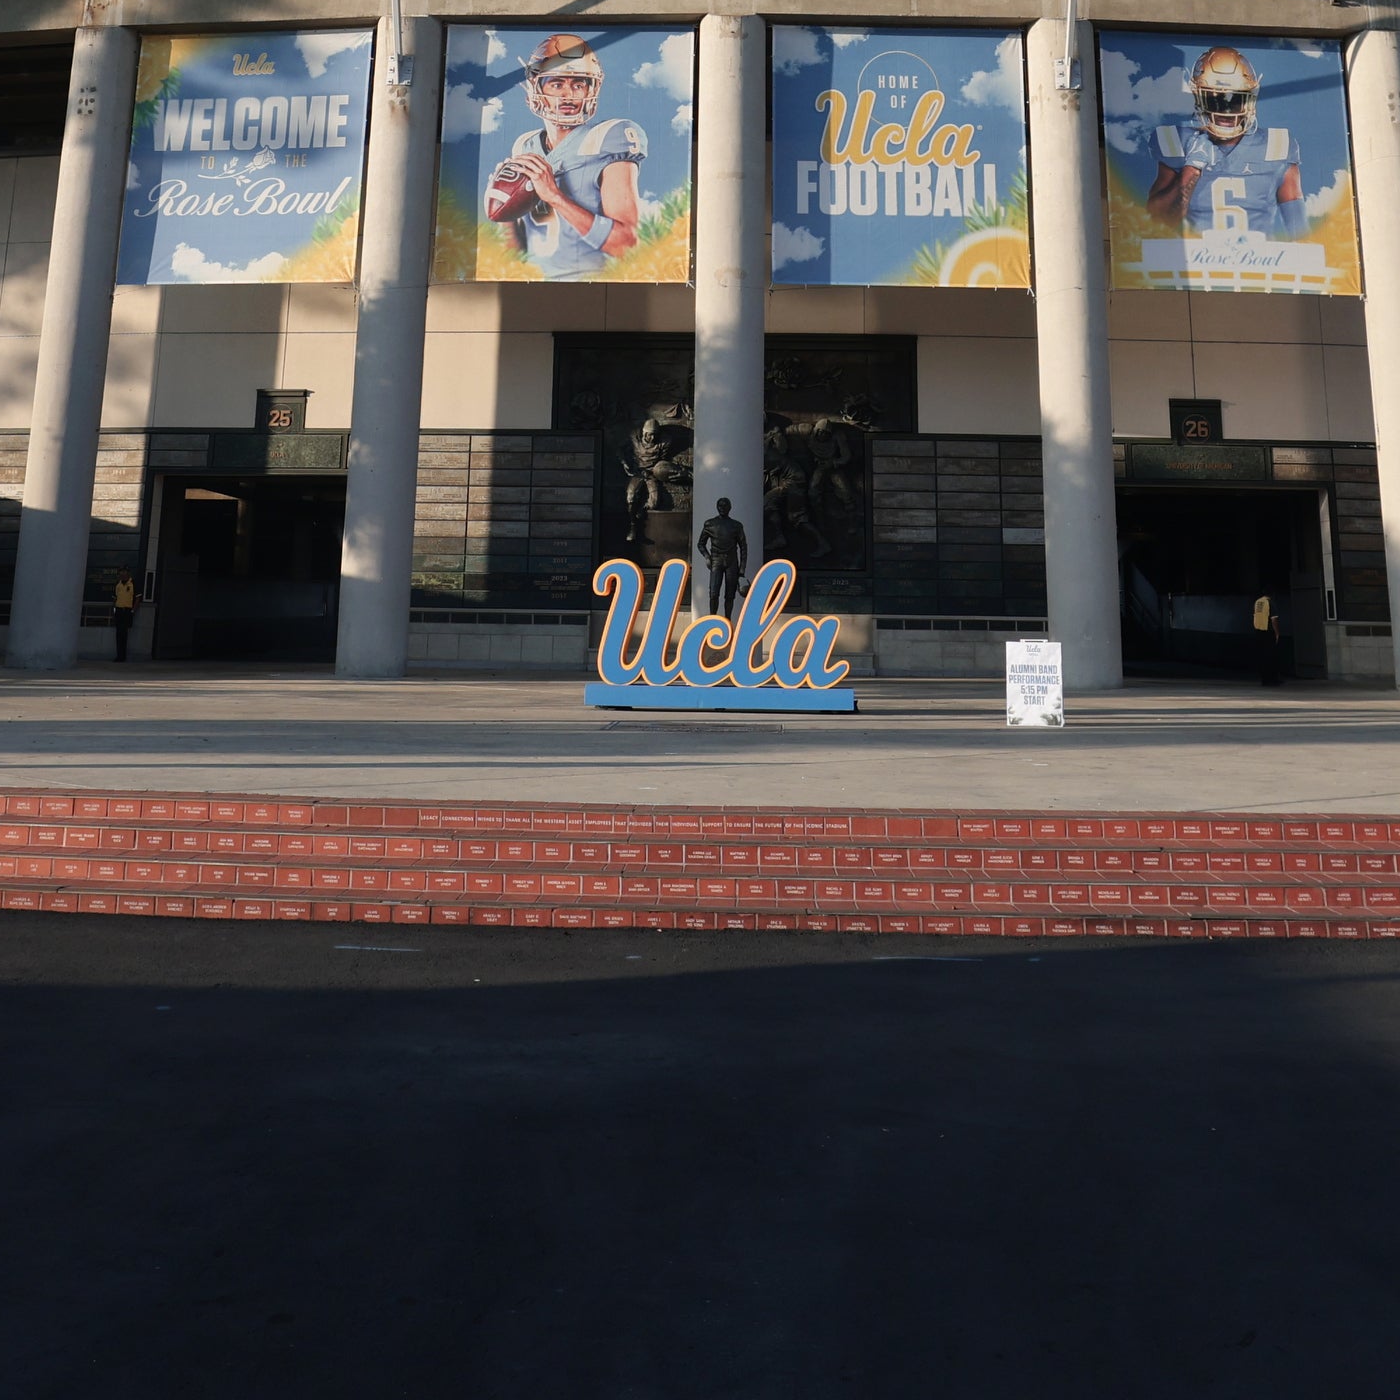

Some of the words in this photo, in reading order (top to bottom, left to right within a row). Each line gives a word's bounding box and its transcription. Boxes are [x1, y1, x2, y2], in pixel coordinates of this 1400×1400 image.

[232, 53, 275, 76] Ucla
[877, 75, 919, 90] HOME
[890, 94, 907, 110] OF
[153, 94, 350, 152] WELCOME
[815, 89, 981, 168] Ucla
[201, 155, 215, 170] TO
[285, 154, 308, 168] THE
[134, 179, 235, 218] Rose
[234, 176, 353, 217] Bowl
[797, 160, 1004, 218] FOOTBALL
[1189, 247, 1232, 268] Rose
[1230, 246, 1285, 268] Bowl
[268, 409, 292, 427] 25
[1184, 420, 1209, 438] 26
[592, 559, 851, 689] Ucla
[1010, 664, 1037, 674] ALUMNI
[1038, 665, 1058, 674] BAND
[1008, 675, 1060, 684] PERFORMANCE
[1020, 685, 1035, 694] 5:15
[1036, 685, 1048, 694] PM
[1024, 696, 1046, 705] START
